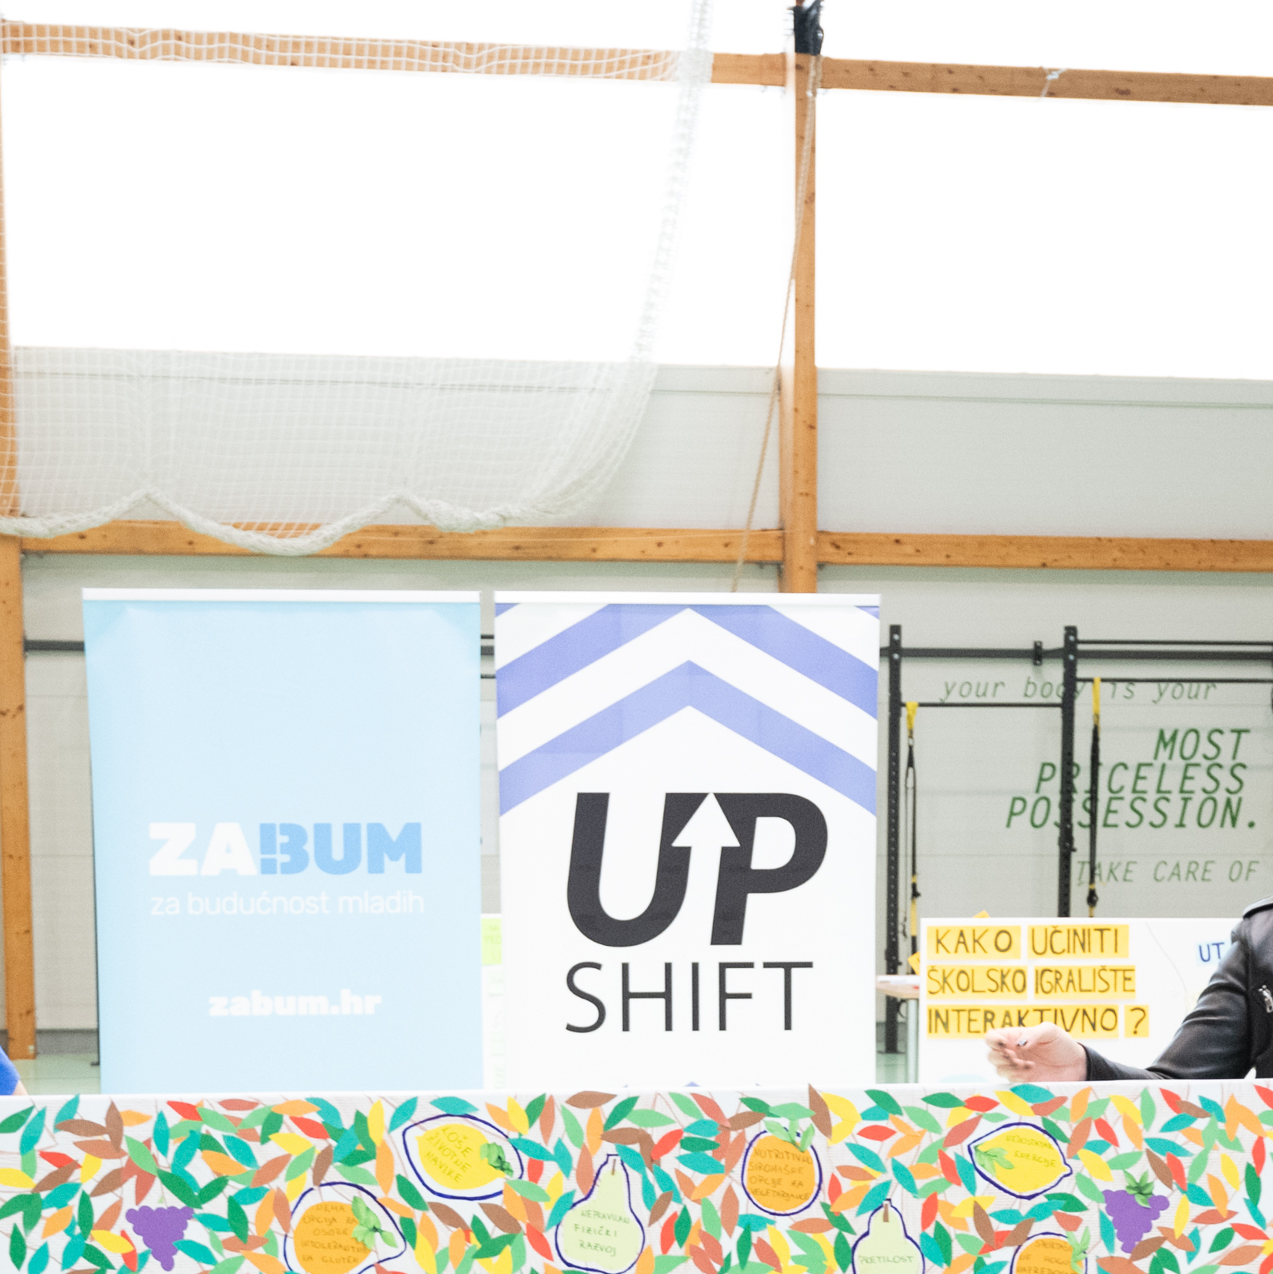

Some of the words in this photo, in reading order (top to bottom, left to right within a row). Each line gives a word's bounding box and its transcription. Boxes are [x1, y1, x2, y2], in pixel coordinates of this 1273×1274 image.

[939, 679, 1006, 703] your
[1151, 681, 1218, 703] your
[1153, 729, 1251, 761] MOST
[1035, 763, 1247, 795] PRCELESS
[1006, 797, 1258, 829] POSESSION.
[148, 822, 423, 876] ZABUM
[567, 792, 828, 947] UP
[1077, 860, 1137, 882] TAKE
[1153, 861, 1214, 882] CARE
[1226, 861, 1260, 882] OF
[151, 895, 181, 914] za
[188, 889, 330, 915] budućnost
[338, 890, 425, 914] mladih
[935, 929, 1013, 954] KAKO
[1031, 925, 1120, 956] UČINITI
[927, 967, 1026, 994] ŠKOLSKO
[1035, 967, 1136, 994] IGRALIŠTE
[209, 990, 382, 1017] zabum.hr
[565, 961, 814, 1033] SHIFT
[928, 1007, 1118, 1034] INTERAKTIVNO
[425, 1133, 472, 1173] ŽIVOTNE
[441, 1126, 472, 1157] LOŠE
[426, 1152, 462, 1183] NAVIKE
[749, 1176, 783, 1187] OPCIJE
[574, 1223, 617, 1237] FIZIČKI
[321, 1255, 359, 1264] GLUTEN
[579, 1240, 616, 1257] RAZVOJ
[858, 1254, 915, 1266] PRETILOST
